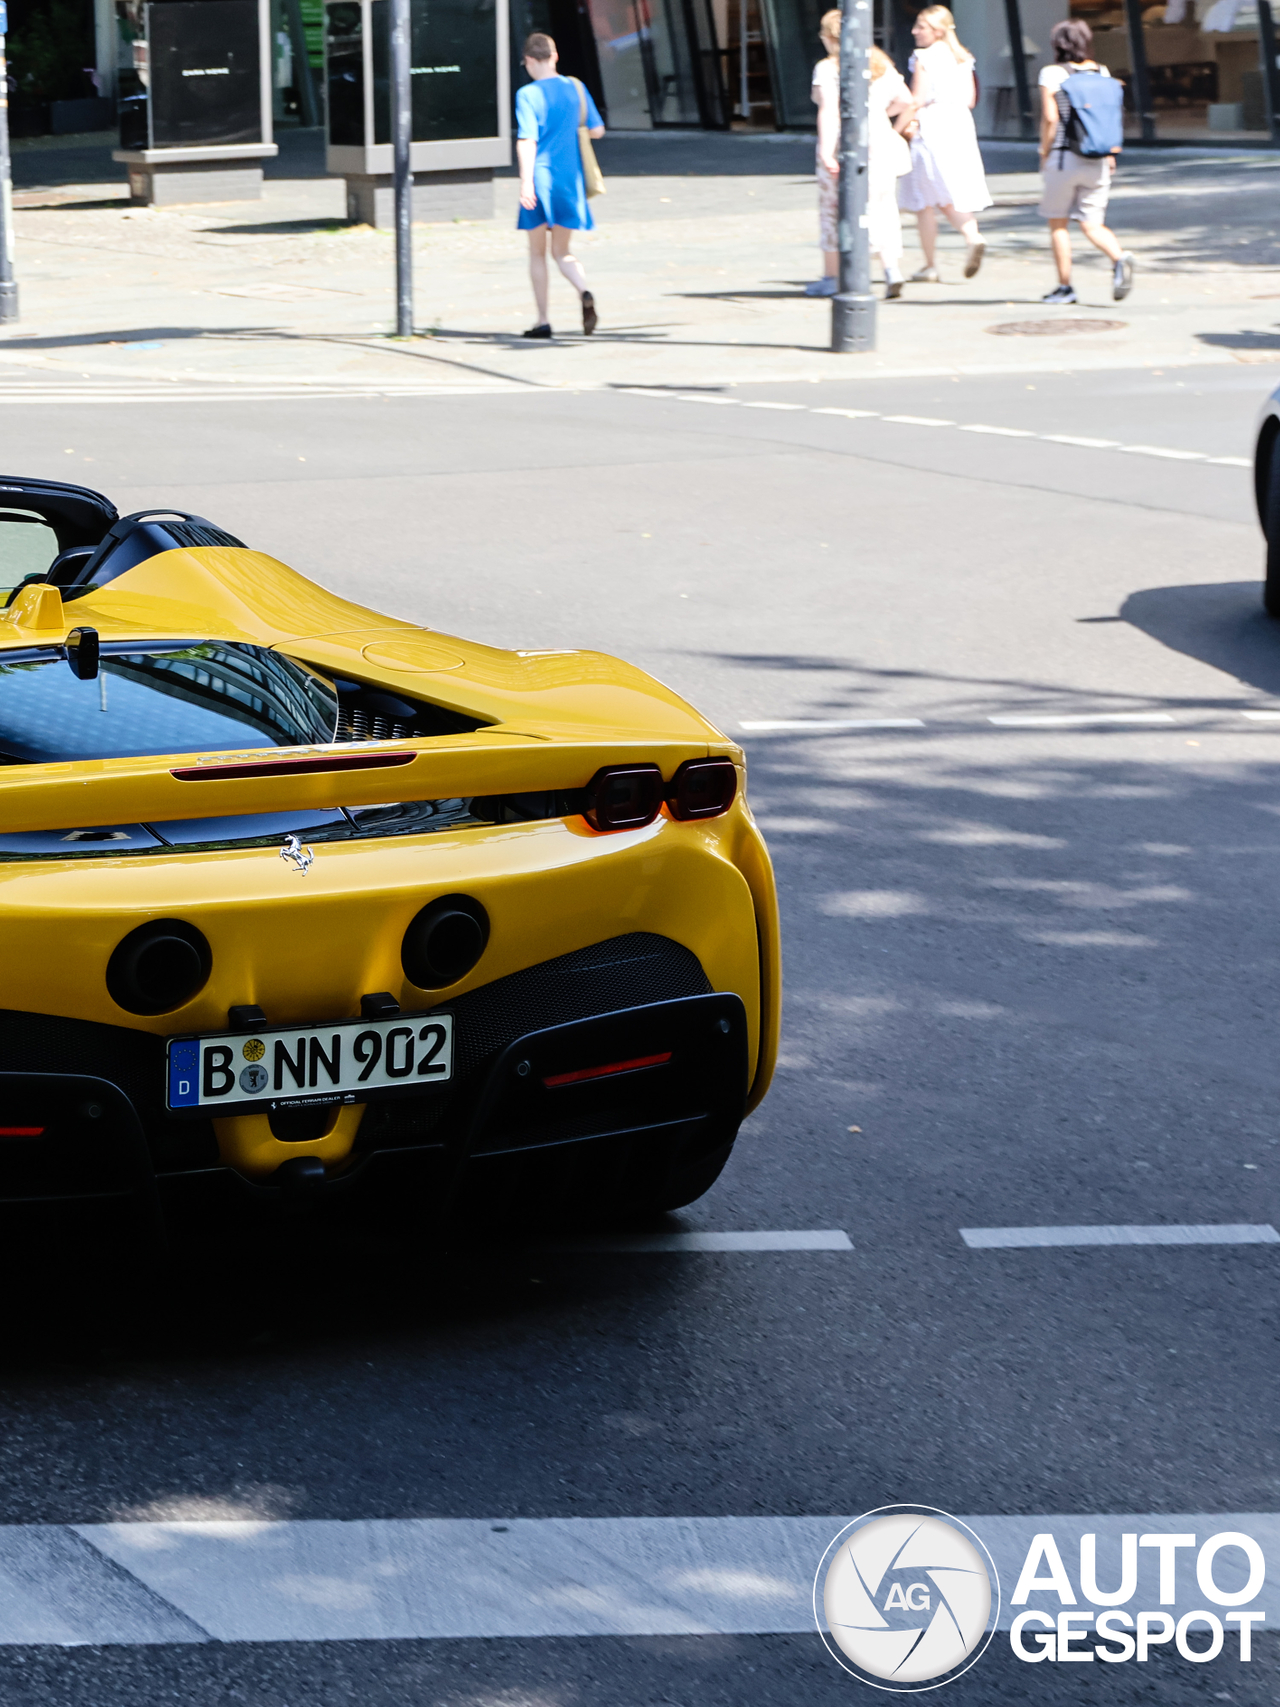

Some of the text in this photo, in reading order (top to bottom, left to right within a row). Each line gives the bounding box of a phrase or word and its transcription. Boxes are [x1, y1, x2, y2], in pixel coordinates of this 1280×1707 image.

[203, 1045, 236, 1097] B
[273, 1034, 341, 1090] NN
[353, 1023, 447, 1081] 902
[178, 1080, 190, 1095] D
